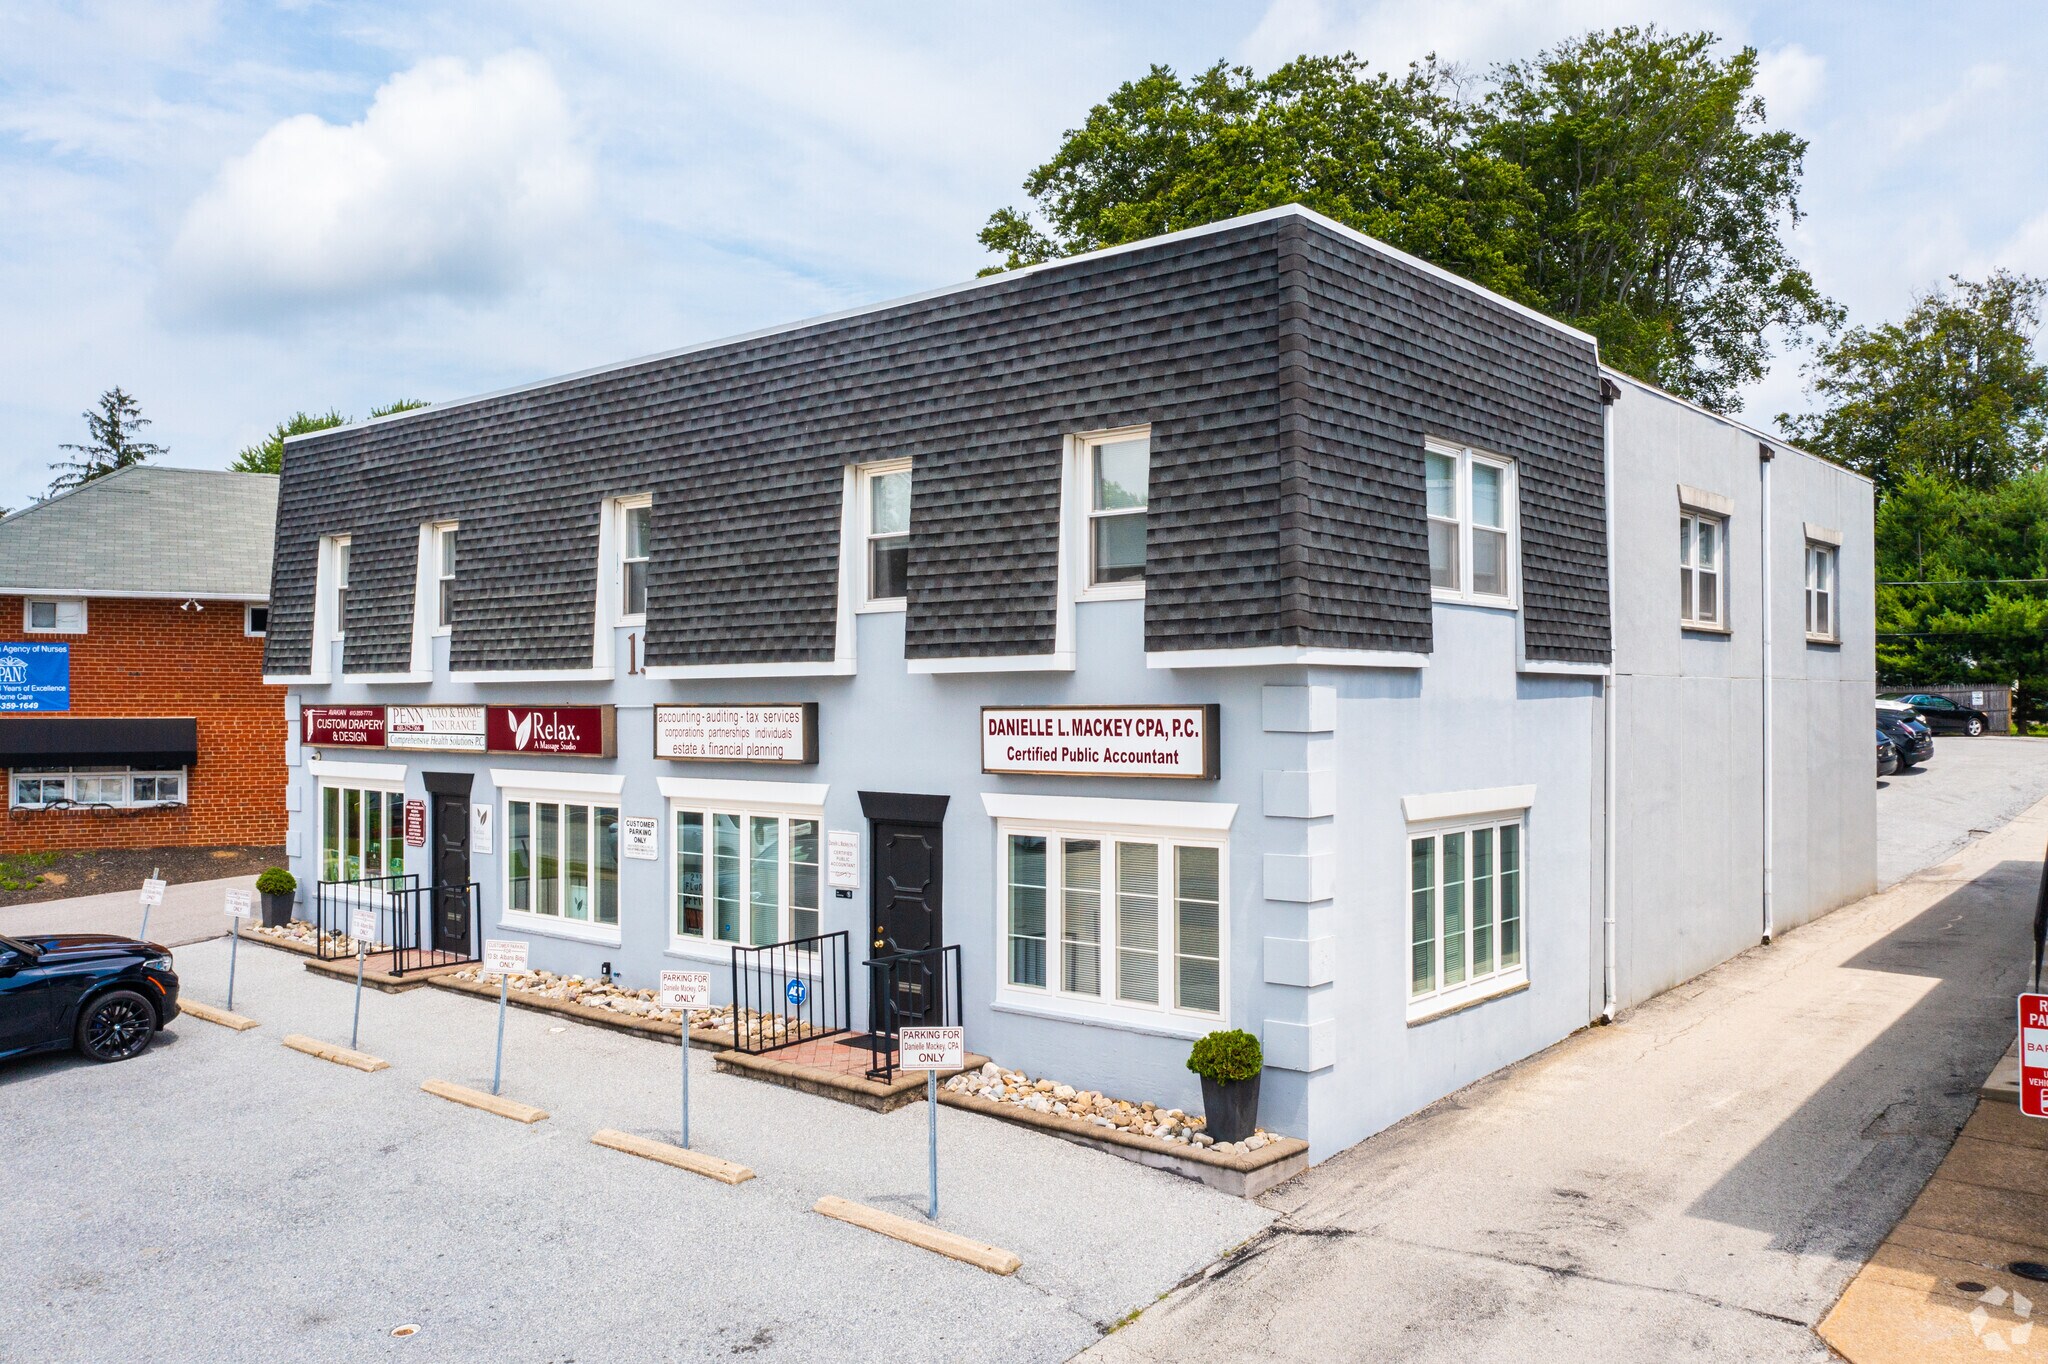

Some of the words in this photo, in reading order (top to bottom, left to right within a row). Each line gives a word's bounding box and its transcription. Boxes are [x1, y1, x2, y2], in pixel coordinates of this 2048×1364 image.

[3, 645, 31, 654] Agency
[41, 645, 67, 653] Nurses
[393, 707, 424, 723] PENN
[427, 707, 448, 718] AUTO
[450, 708, 455, 718] &
[458, 708, 482, 718] HOME
[658, 711, 701, 725] accounting
[706, 710, 739, 725] auditing
[746, 711, 759, 723] tax
[763, 710, 800, 723] services
[317, 719, 347, 729] CUSTOM
[348, 719, 384, 730] DRAPERY
[432, 720, 477, 731] INSURANCE
[533, 711, 580, 740] Relax.
[989, 718, 1053, 737] DANIELLE
[1058, 718, 1069, 737] L.
[1072, 719, 1133, 738] MACKEY
[1135, 719, 1169, 741] CPA,
[1172, 719, 1199, 738] P.C.
[333, 731, 338, 741] &
[339, 731, 367, 742] DESIGN
[665, 727, 704, 740] corporations
[708, 727, 750, 740] partnerships
[755, 727, 792, 739] individuals
[390, 734, 429, 747] Comprehensive
[431, 736, 448, 745] Health
[449, 736, 474, 746] Solutions
[534, 741, 539, 749] A
[539, 741, 560, 752] Massage
[560, 741, 577, 751] Studio
[673, 742, 698, 755] estate
[700, 744, 706, 755] &
[708, 742, 743, 756] financial
[746, 743, 784, 759] planning
[1007, 746, 1057, 762] Certified
[1061, 747, 1099, 763] Public
[1103, 747, 1179, 765] Accountant
[626, 820, 655, 828] CUSTOMER
[629, 828, 652, 836] PARKING
[633, 836, 646, 844] ONLY
[663, 974, 692, 983] PARKING
[694, 974, 708, 983] FOR
[664, 984, 680, 992] Danielle
[674, 994, 696, 1003] ONLY
[2029, 1013, 2048, 1026] PA
[903, 1031, 940, 1039] PARKING
[943, 1031, 960, 1039] FOR
[904, 1042, 925, 1051] Danielle
[948, 1042, 959, 1051] CPA
[918, 1054, 945, 1063] ONLY
